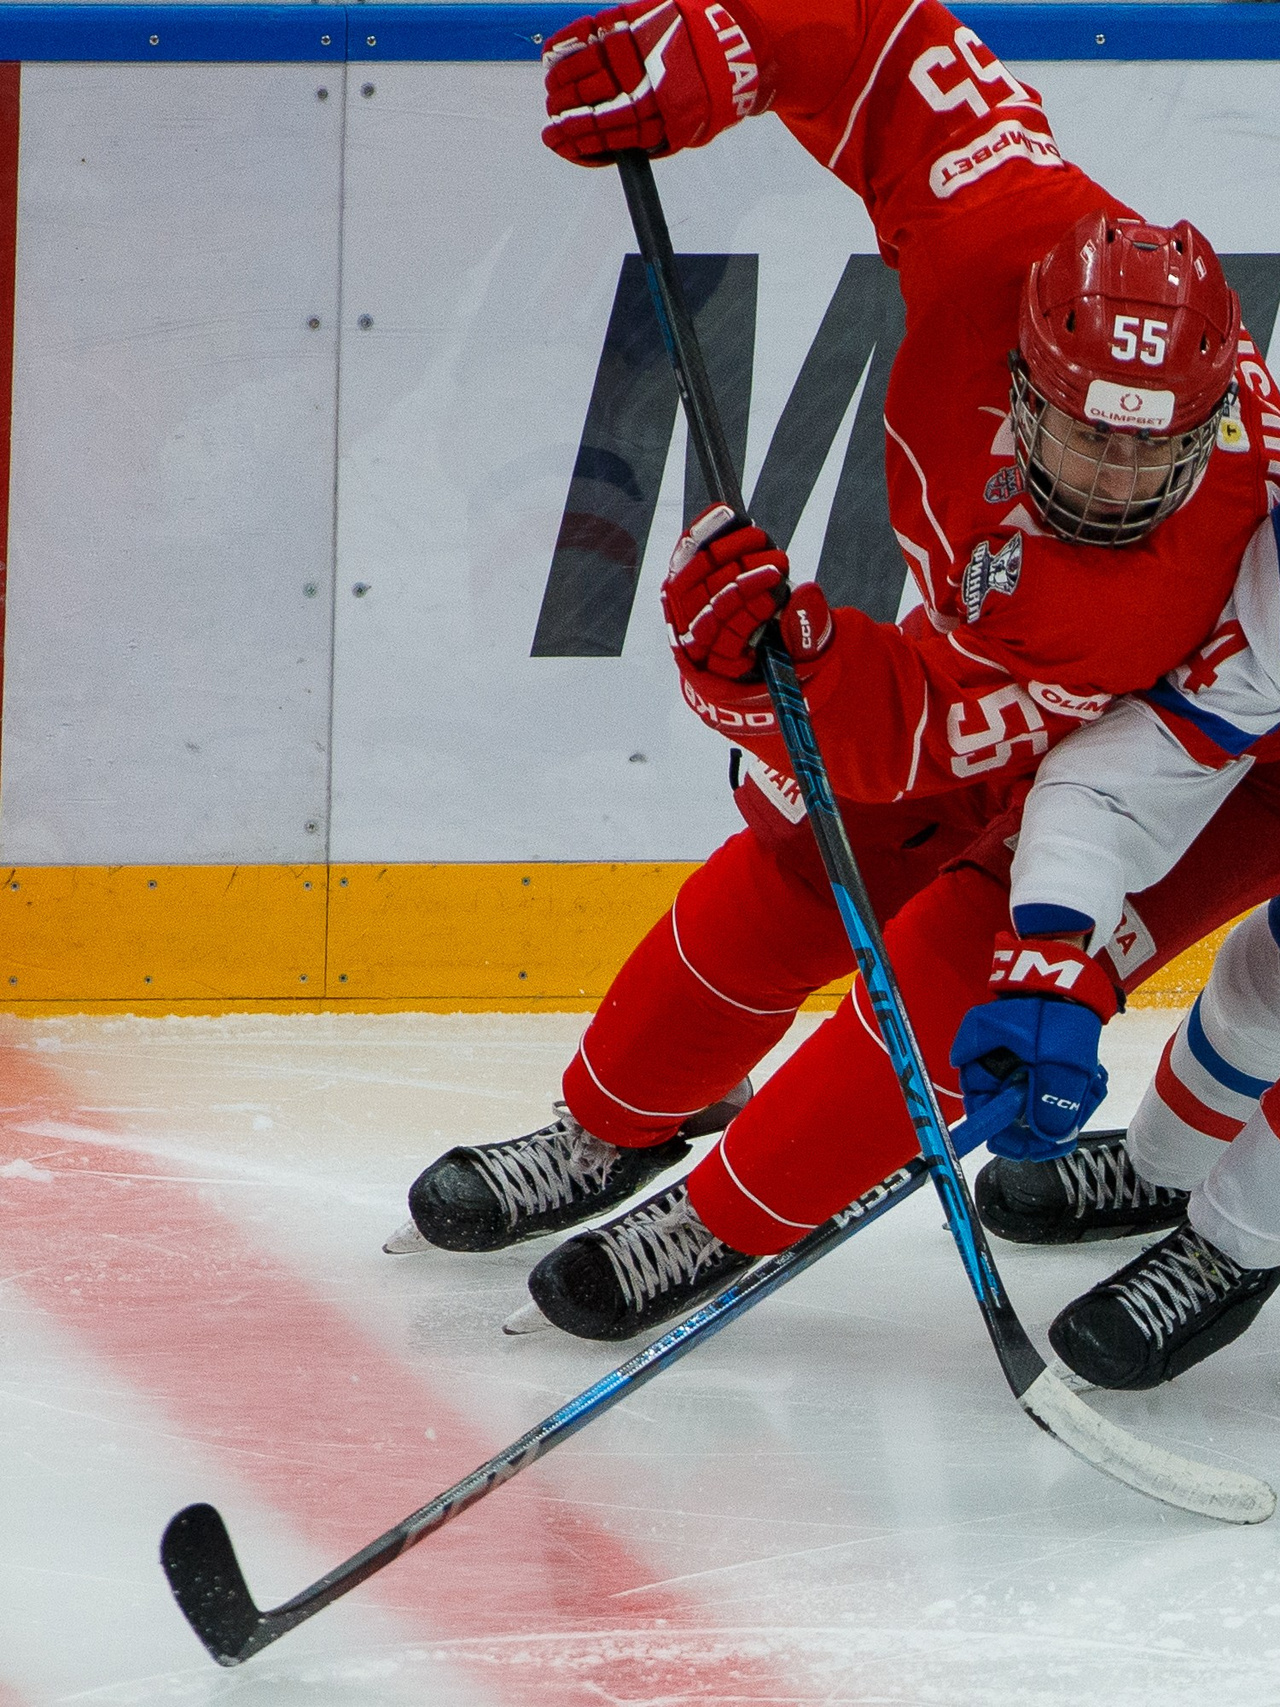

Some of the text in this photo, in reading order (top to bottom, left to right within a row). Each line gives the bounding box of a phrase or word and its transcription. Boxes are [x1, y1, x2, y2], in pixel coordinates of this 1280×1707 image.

[908, 26, 1031, 118] 55
[1111, 314, 1167, 365] 55
[1089, 408, 1165, 426] OLIMPBET
[796, 609, 811, 649] CCM
[684, 677, 809, 727] ОСКВ
[949, 683, 1049, 779] 55
[856, 946, 964, 1223] NEXUS
[1041, 1094, 1080, 1111] CCM
[832, 1167, 912, 1230] CCM
